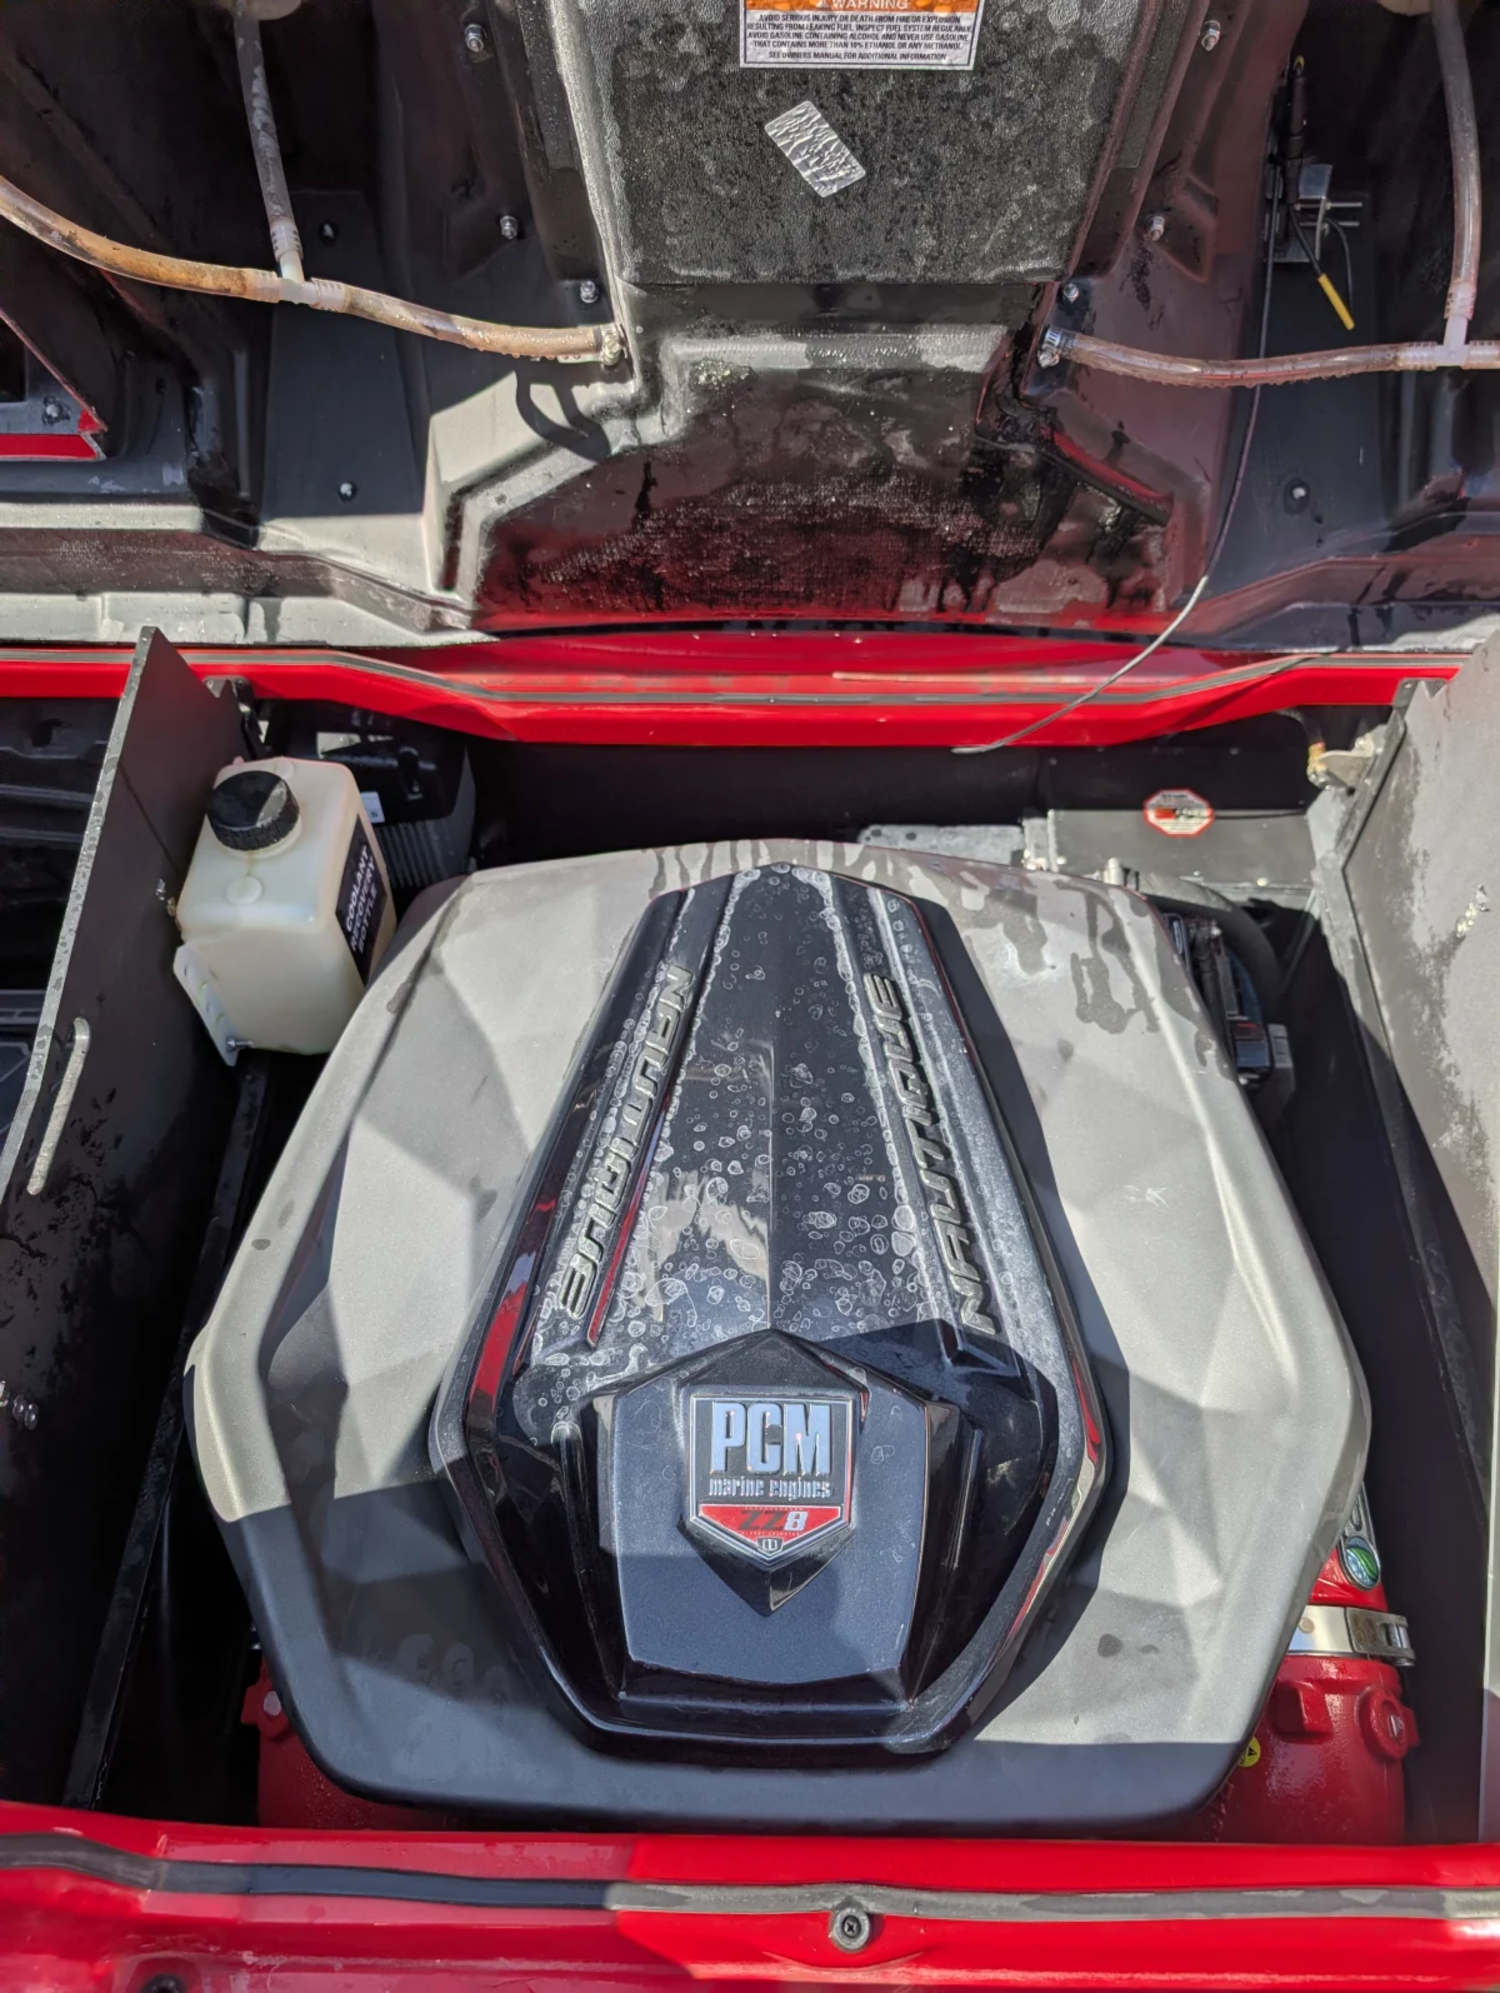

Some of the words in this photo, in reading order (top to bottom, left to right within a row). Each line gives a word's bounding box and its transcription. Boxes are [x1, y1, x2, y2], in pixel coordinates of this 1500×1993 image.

[832, 0, 908, 9] WARNING
[747, 23, 784, 31] RESULTING
[785, 23, 805, 31] FROM
[806, 23, 836, 31] LEAKING
[812, 14, 838, 22] INJURY
[805, 32, 848, 40] CONTAINING
[908, 42, 923, 50] ANY
[782, 51, 812, 59] OWNERS
[346, 845, 369, 932] COOLANT
[351, 855, 375, 952] RECOVERY
[357, 883, 379, 954] BOTTLE
[559, 963, 694, 1320] NAUTIQUE
[864, 972, 997, 1335] NAUTIQUE
[710, 1402, 831, 1476] PCM
[709, 1476, 765, 1496] marine
[769, 1477, 832, 1501] engines
[738, 1509, 808, 1531] ZZ8
